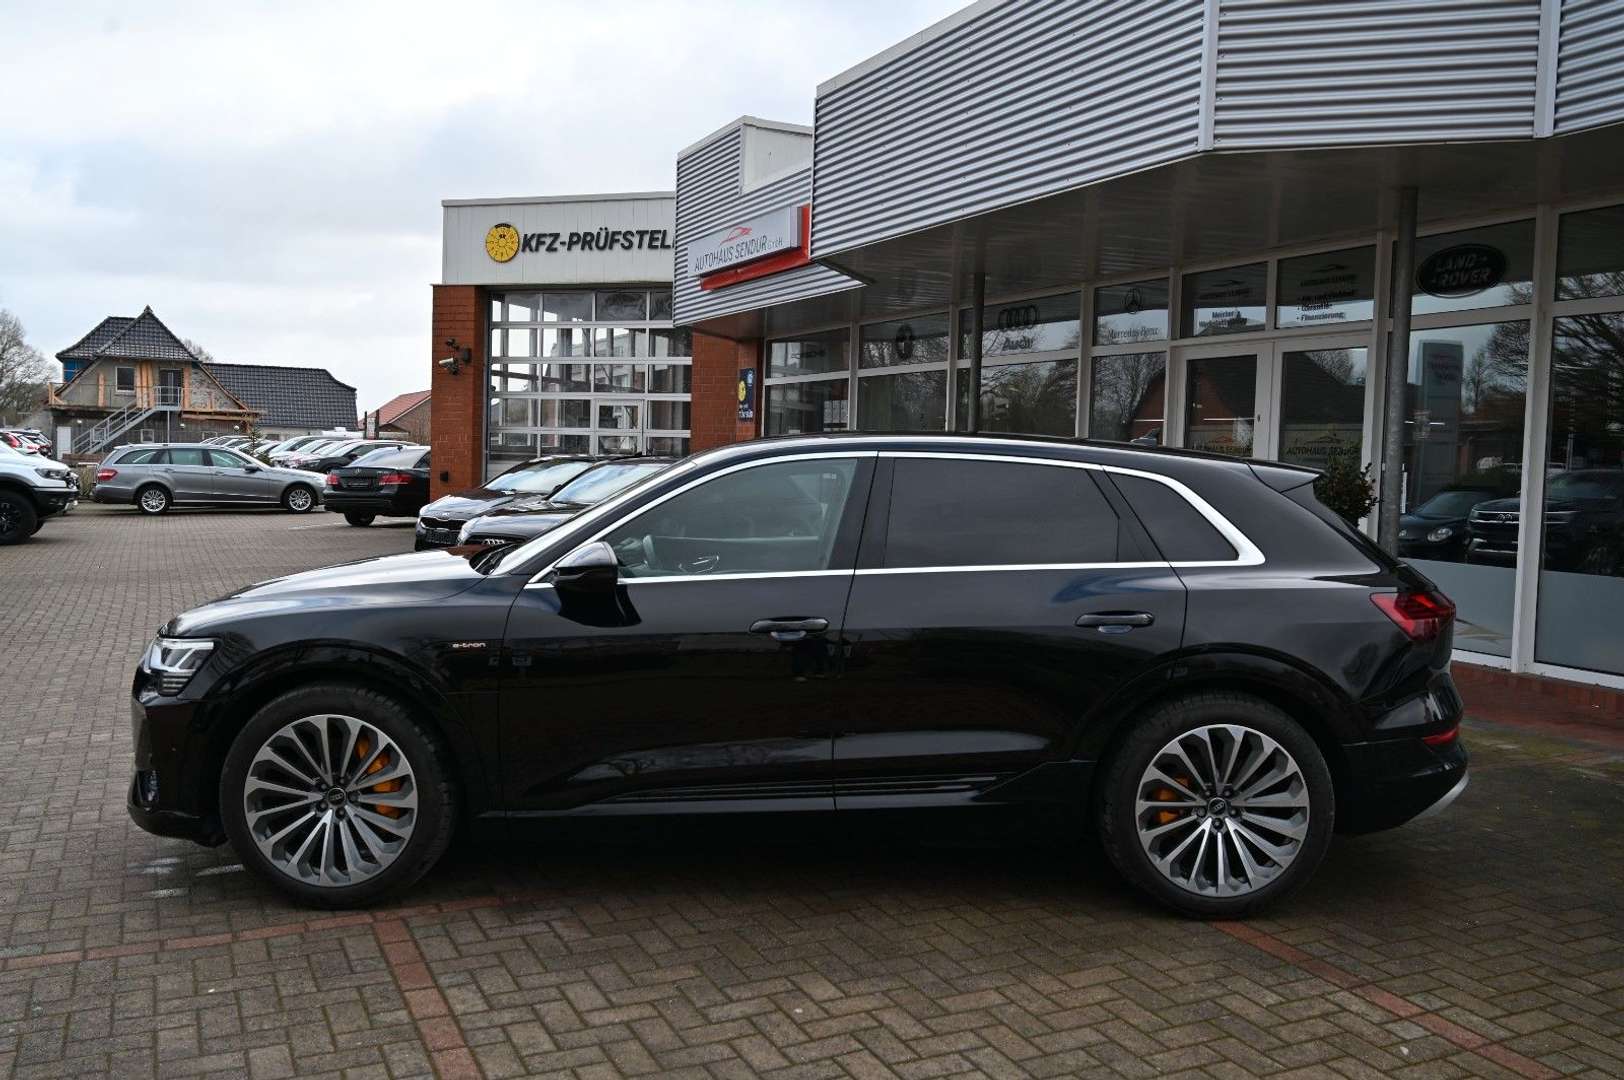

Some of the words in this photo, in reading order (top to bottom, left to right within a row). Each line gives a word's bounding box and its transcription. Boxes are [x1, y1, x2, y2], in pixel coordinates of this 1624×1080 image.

[521, 227, 675, 252] KFZ-PRÜFSTEL
[694, 246, 734, 272] AUTOHAUS
[1438, 268, 1490, 289] ROVER
[1002, 335, 1034, 351] Audi
